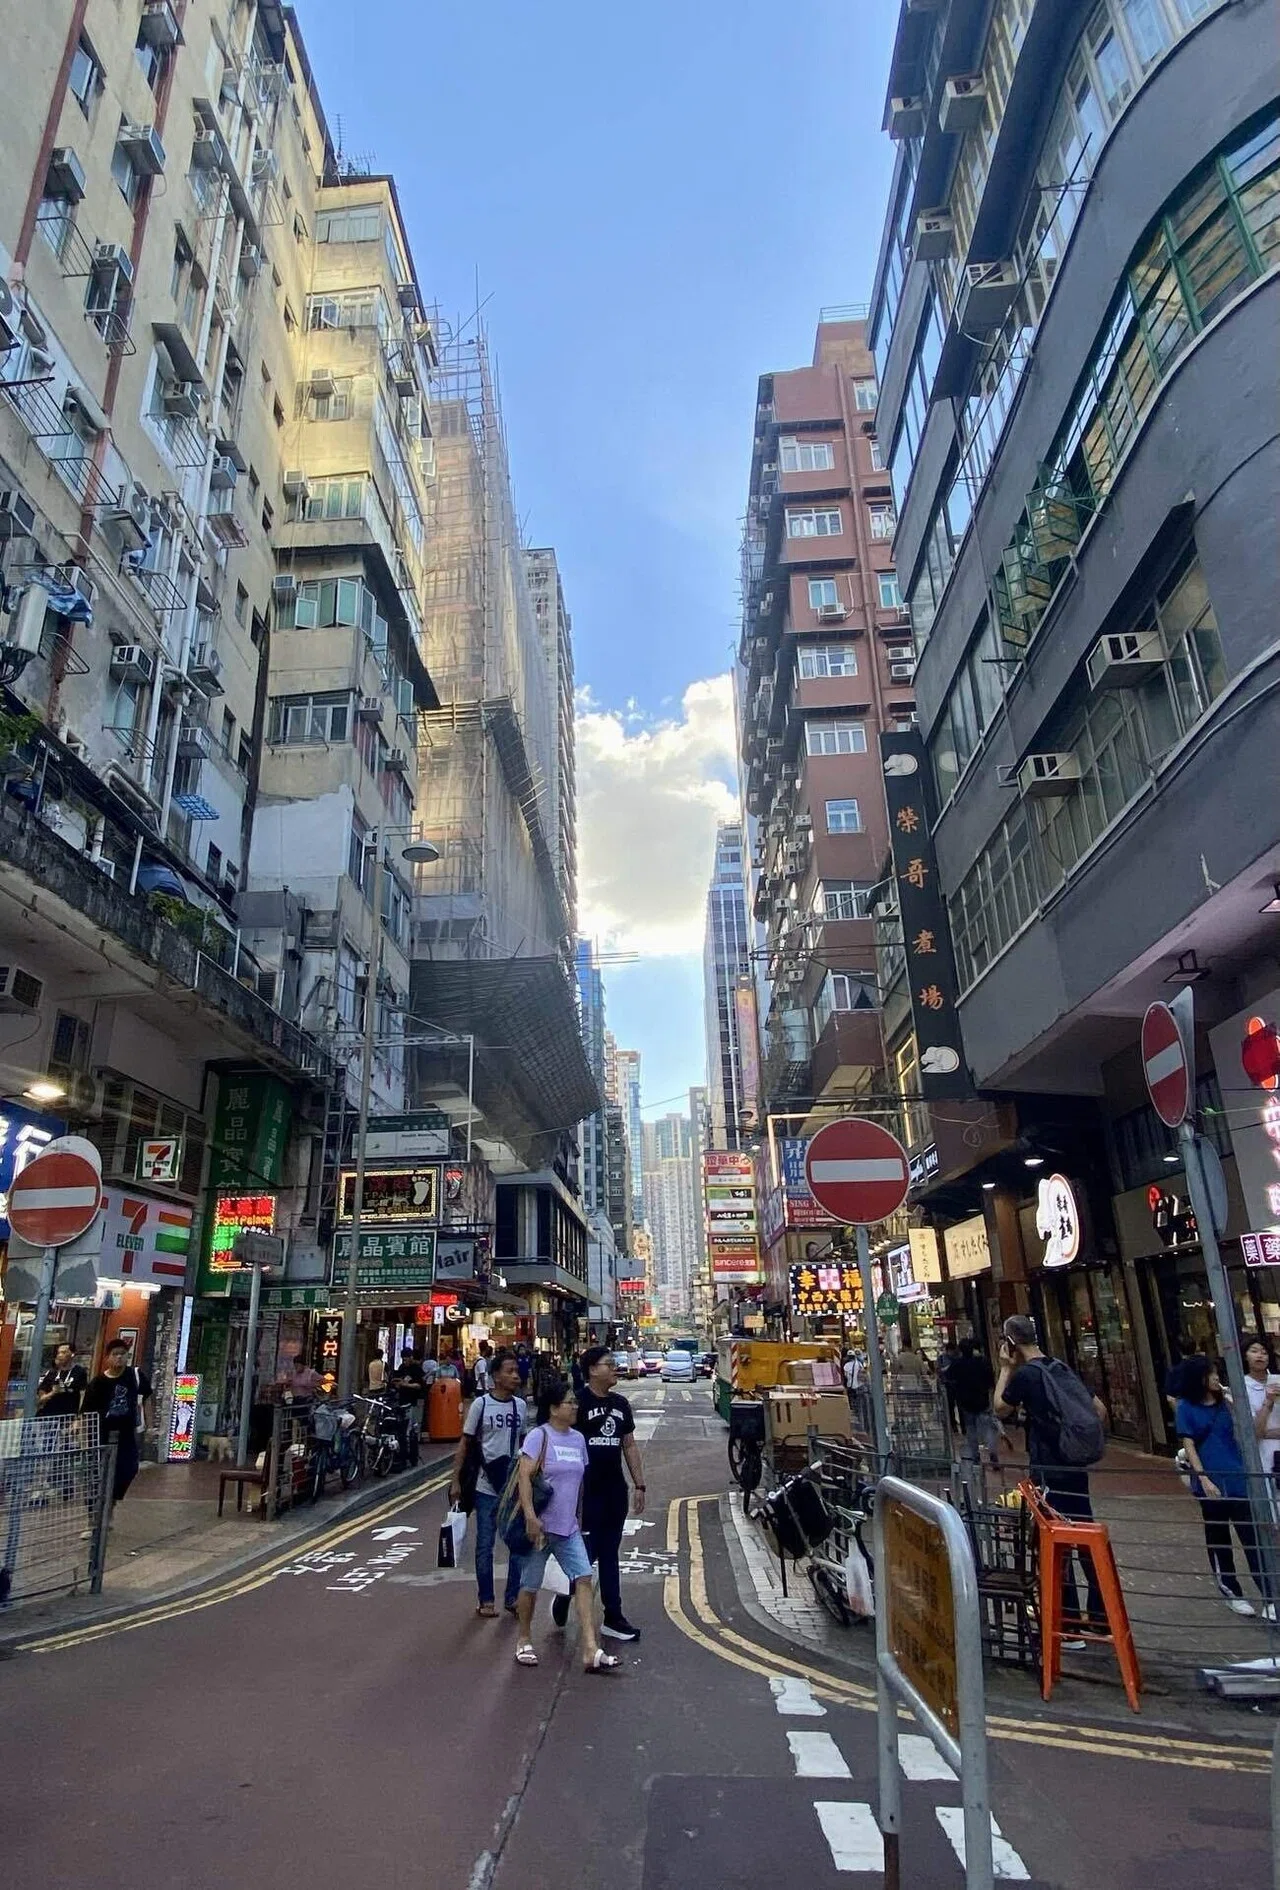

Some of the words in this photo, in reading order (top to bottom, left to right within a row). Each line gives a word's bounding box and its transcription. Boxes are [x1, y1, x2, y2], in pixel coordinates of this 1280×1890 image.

[895, 805, 945, 1012] 榮哥煮場
[218, 1215, 239, 1226] Foot
[239, 1214, 273, 1226] Palace
[116, 1233, 144, 1251] ELEVEN
